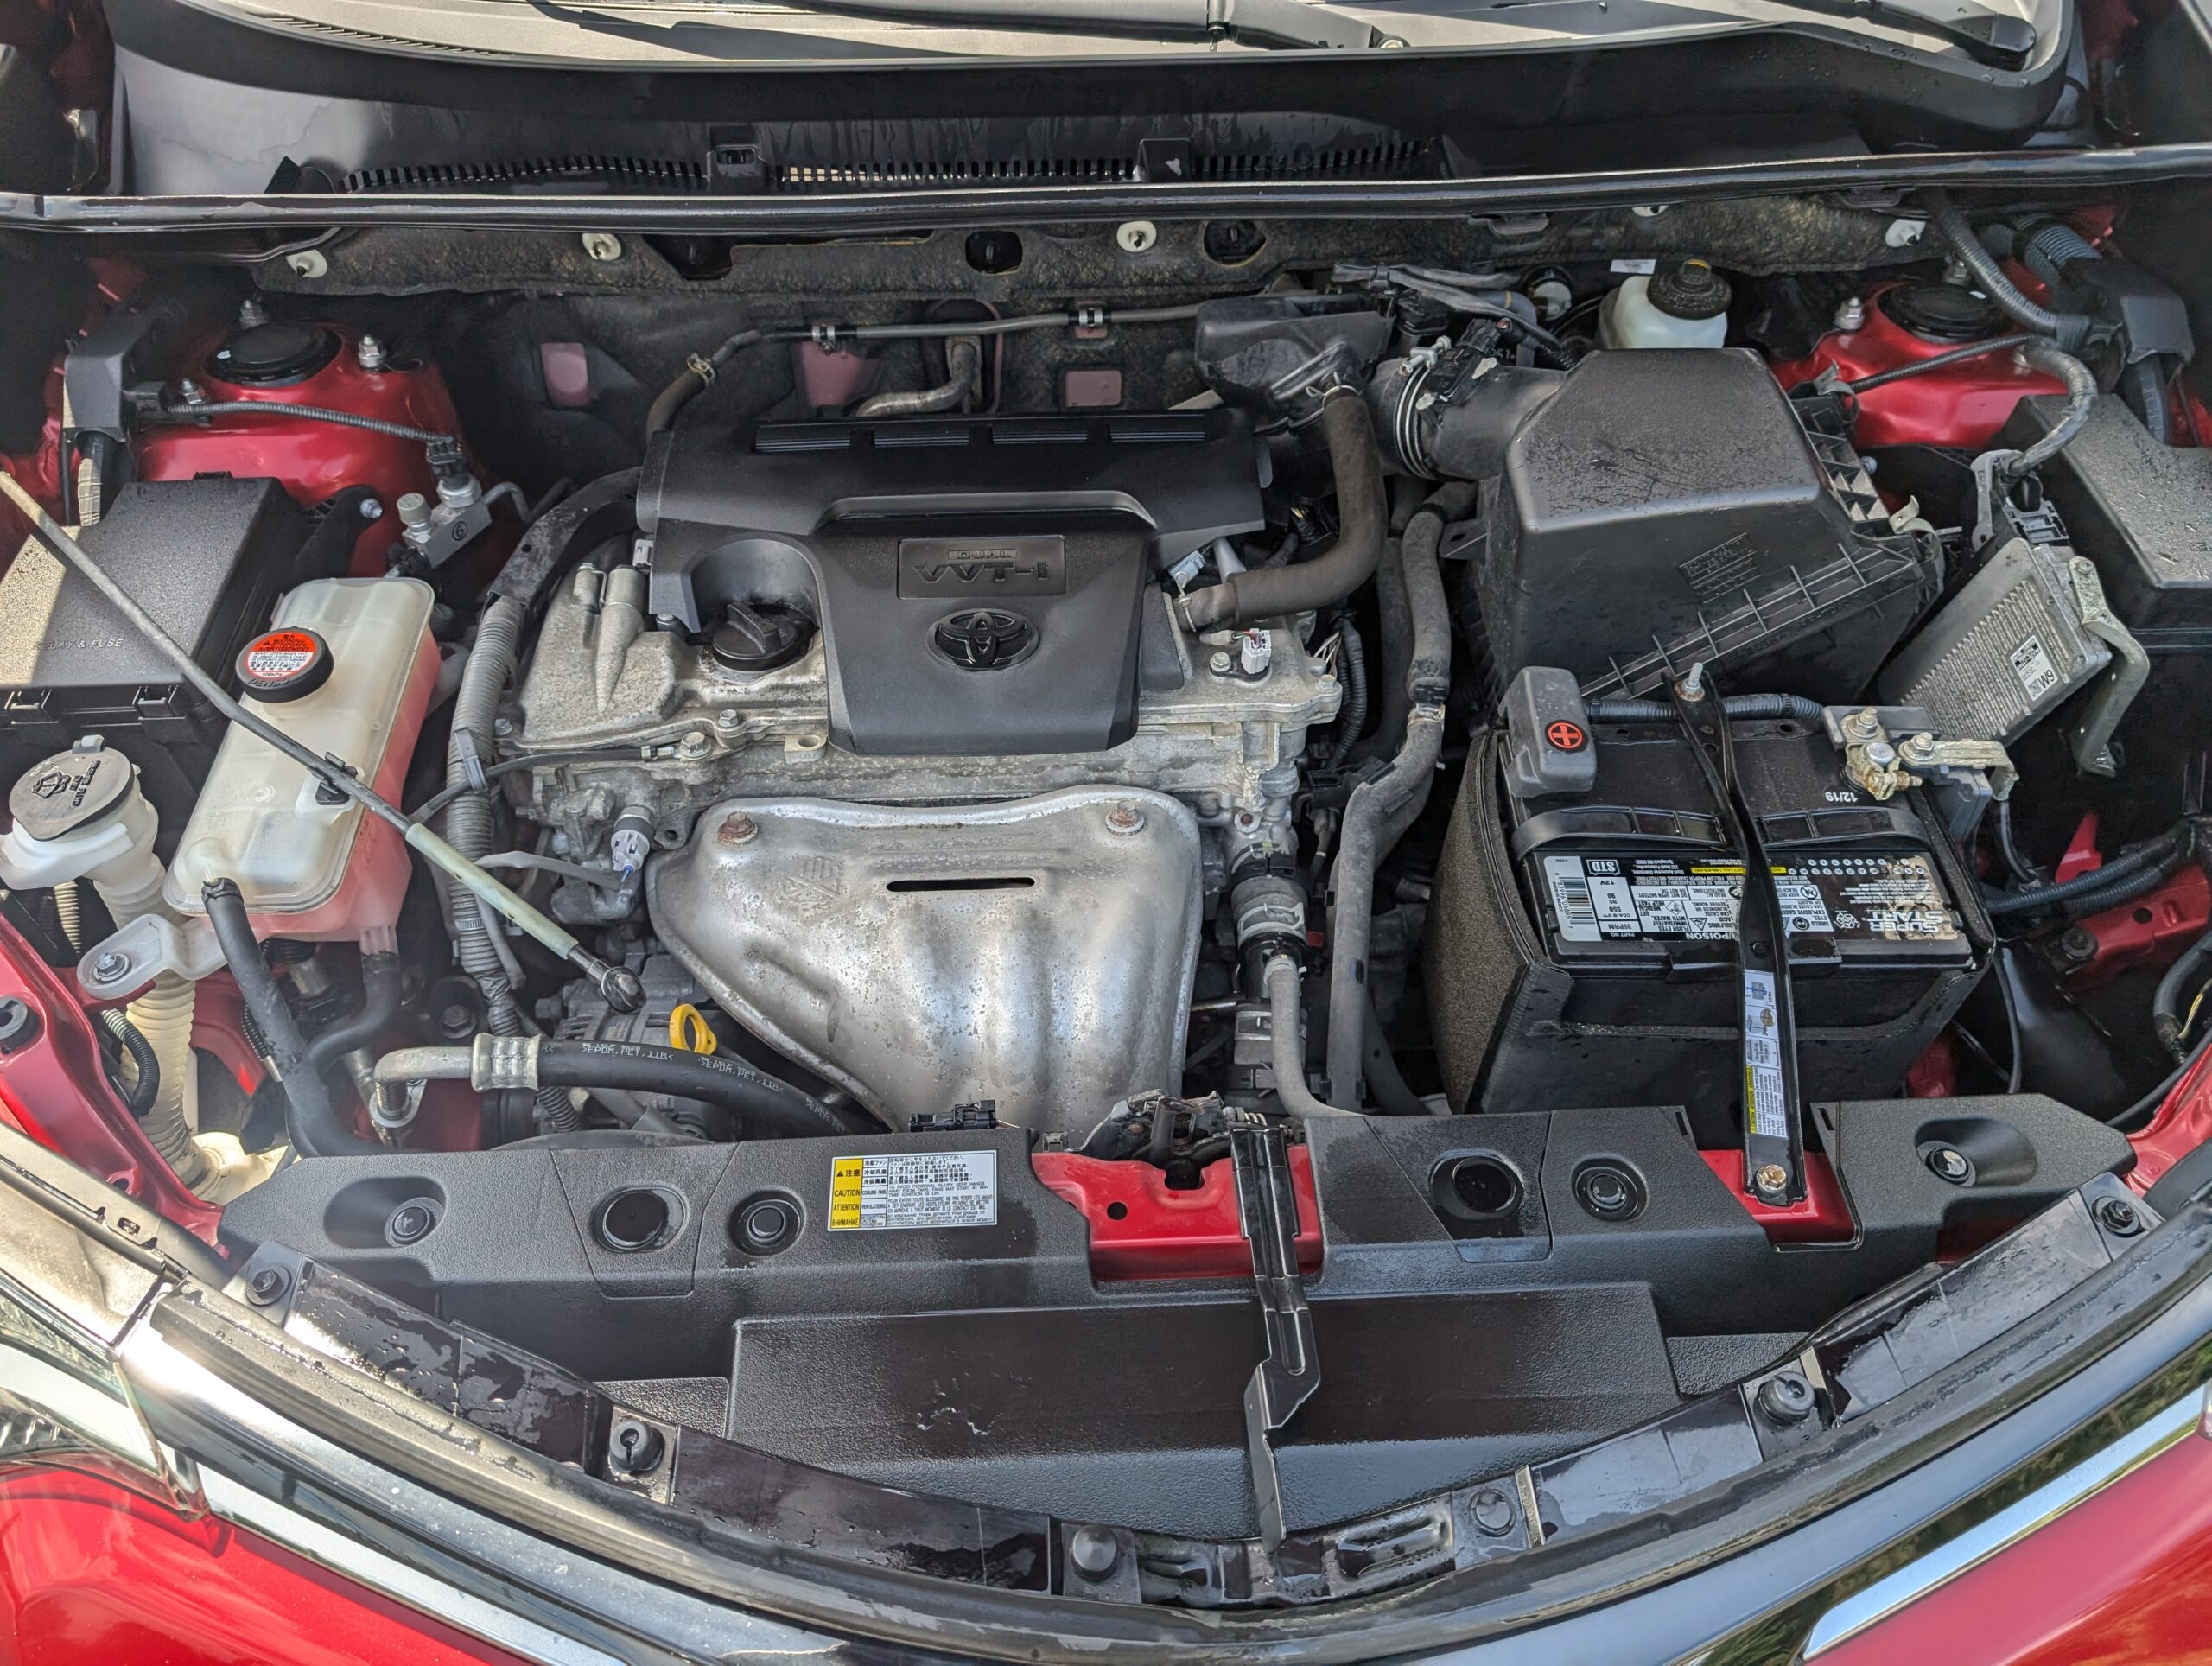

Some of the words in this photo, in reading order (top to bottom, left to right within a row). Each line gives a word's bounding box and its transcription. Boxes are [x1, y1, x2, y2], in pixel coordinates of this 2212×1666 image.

[957, 550, 1012, 560] DUAL
[913, 562, 1048, 583] VVT-i
[90, 639, 124, 649] FUSE
[248, 678, 289, 687] DENSO
[2038, 669, 2055, 689] W9
[1825, 792, 1859, 802] 12/19
[1592, 862, 1616, 872] STD
[1866, 911, 1942, 921] START
[1870, 922, 1939, 932] SUPER
[834, 1189, 861, 1198] CAUTION
[832, 1218, 859, 1226] ВНИМАНИЕ
